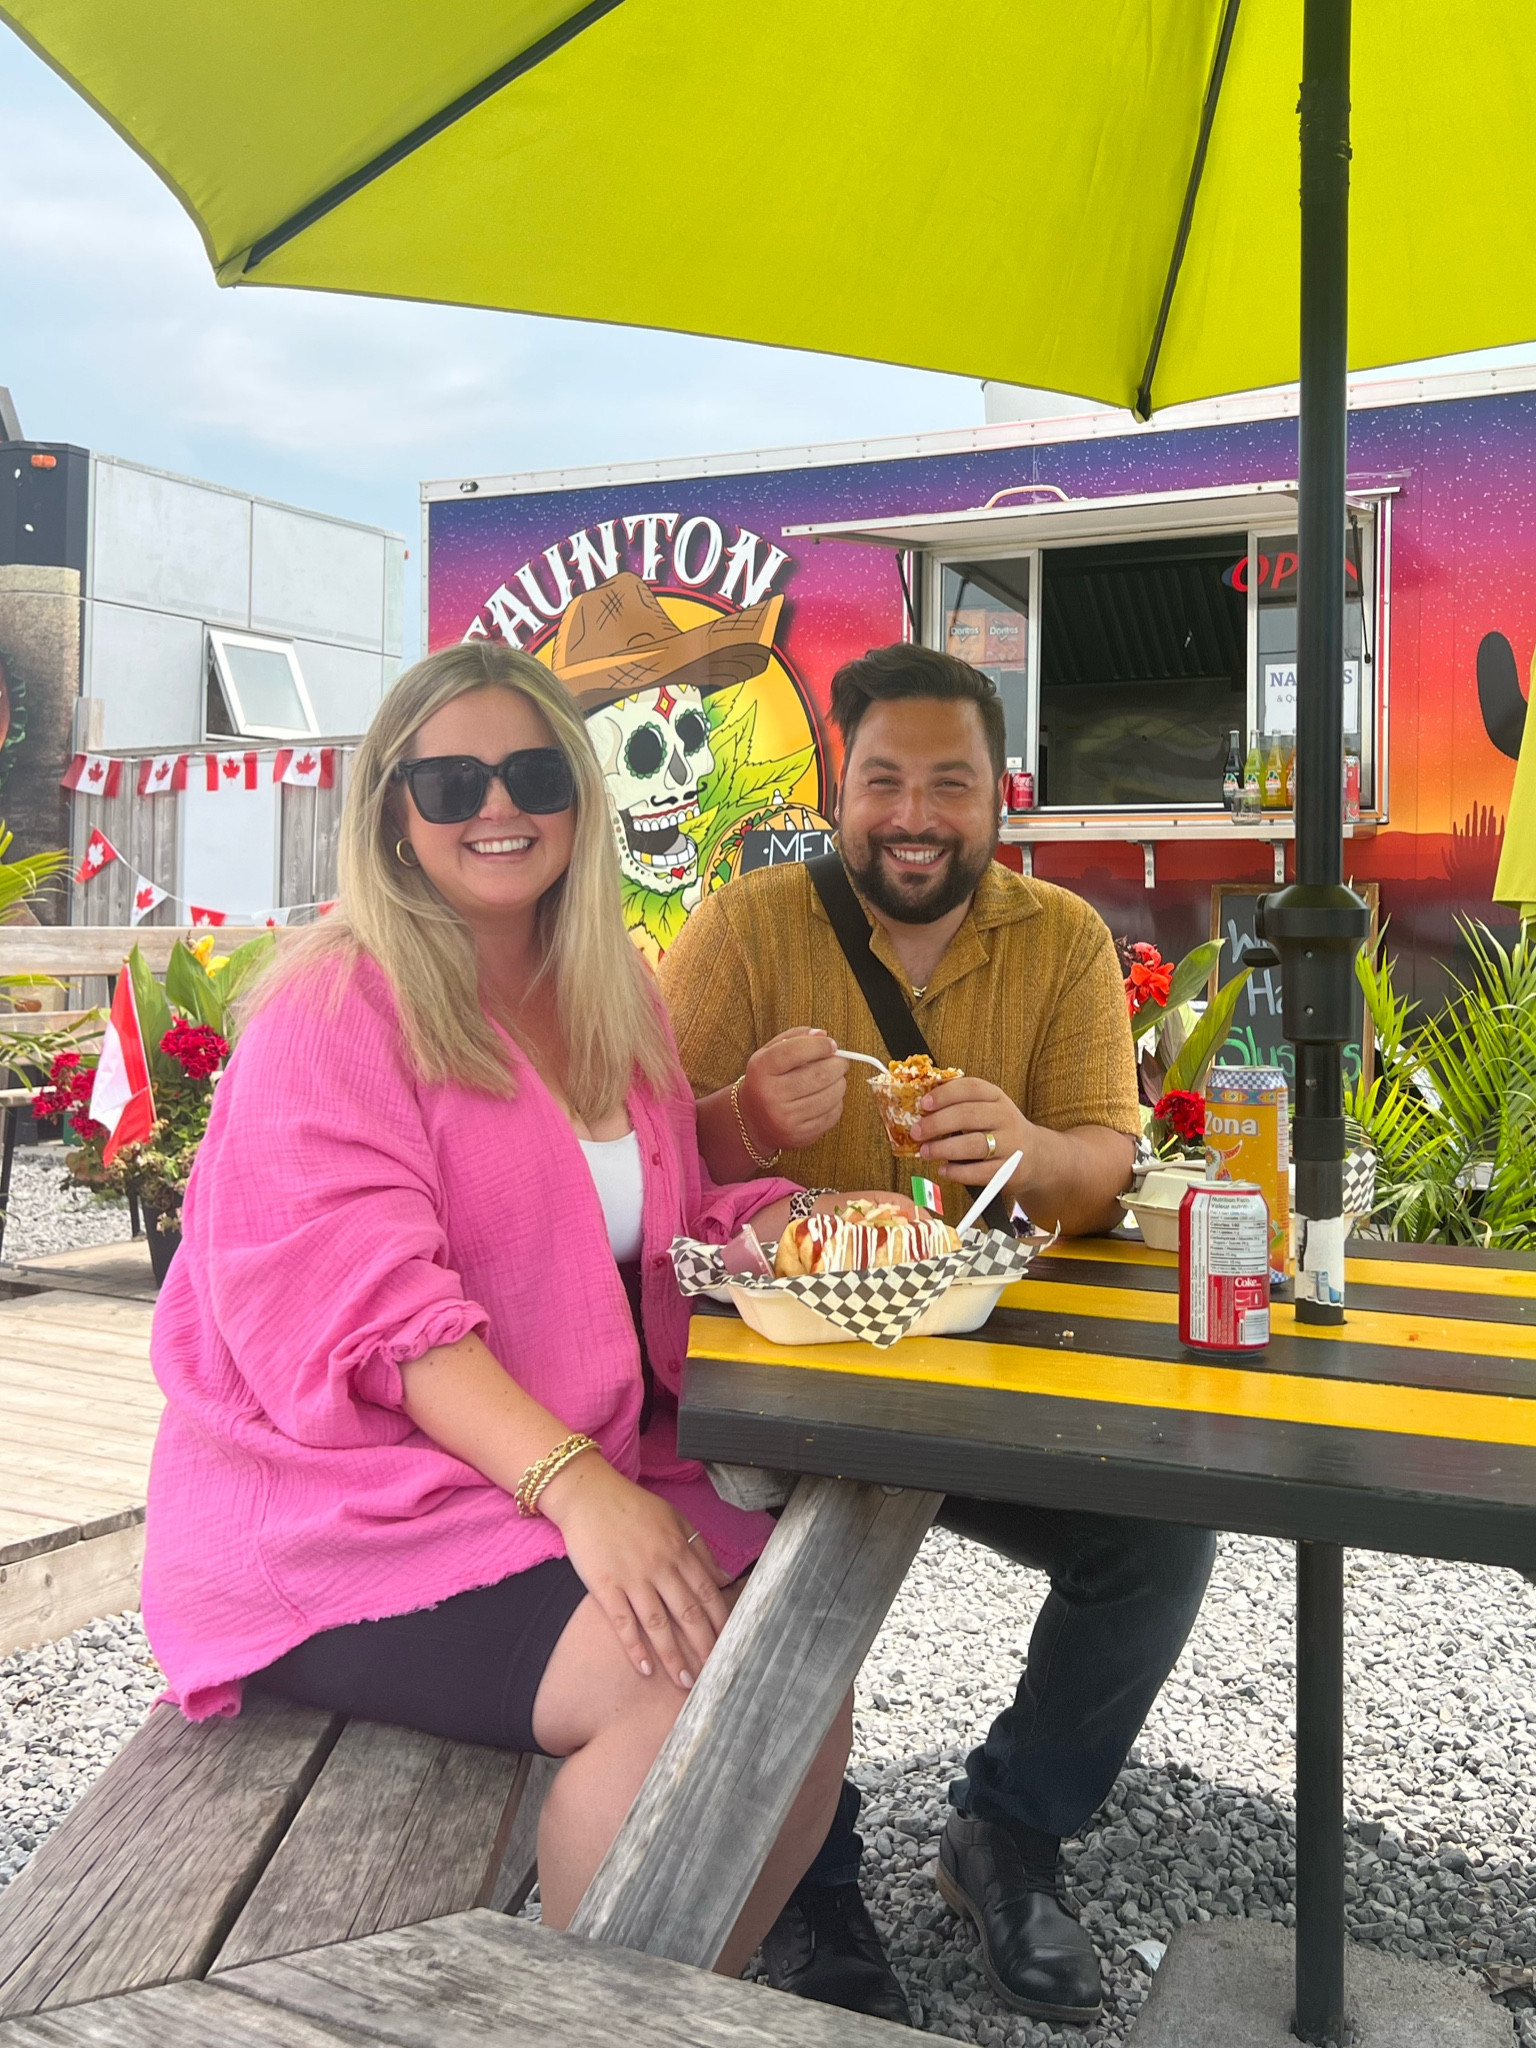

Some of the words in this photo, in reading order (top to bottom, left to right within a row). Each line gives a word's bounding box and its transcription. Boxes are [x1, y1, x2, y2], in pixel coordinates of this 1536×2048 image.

[1232, 552, 1357, 592] OP
[989, 626, 1018, 635] Doritos
[1270, 669, 1353, 687] NAS
[1235, 1277, 1257, 1288] Coke
